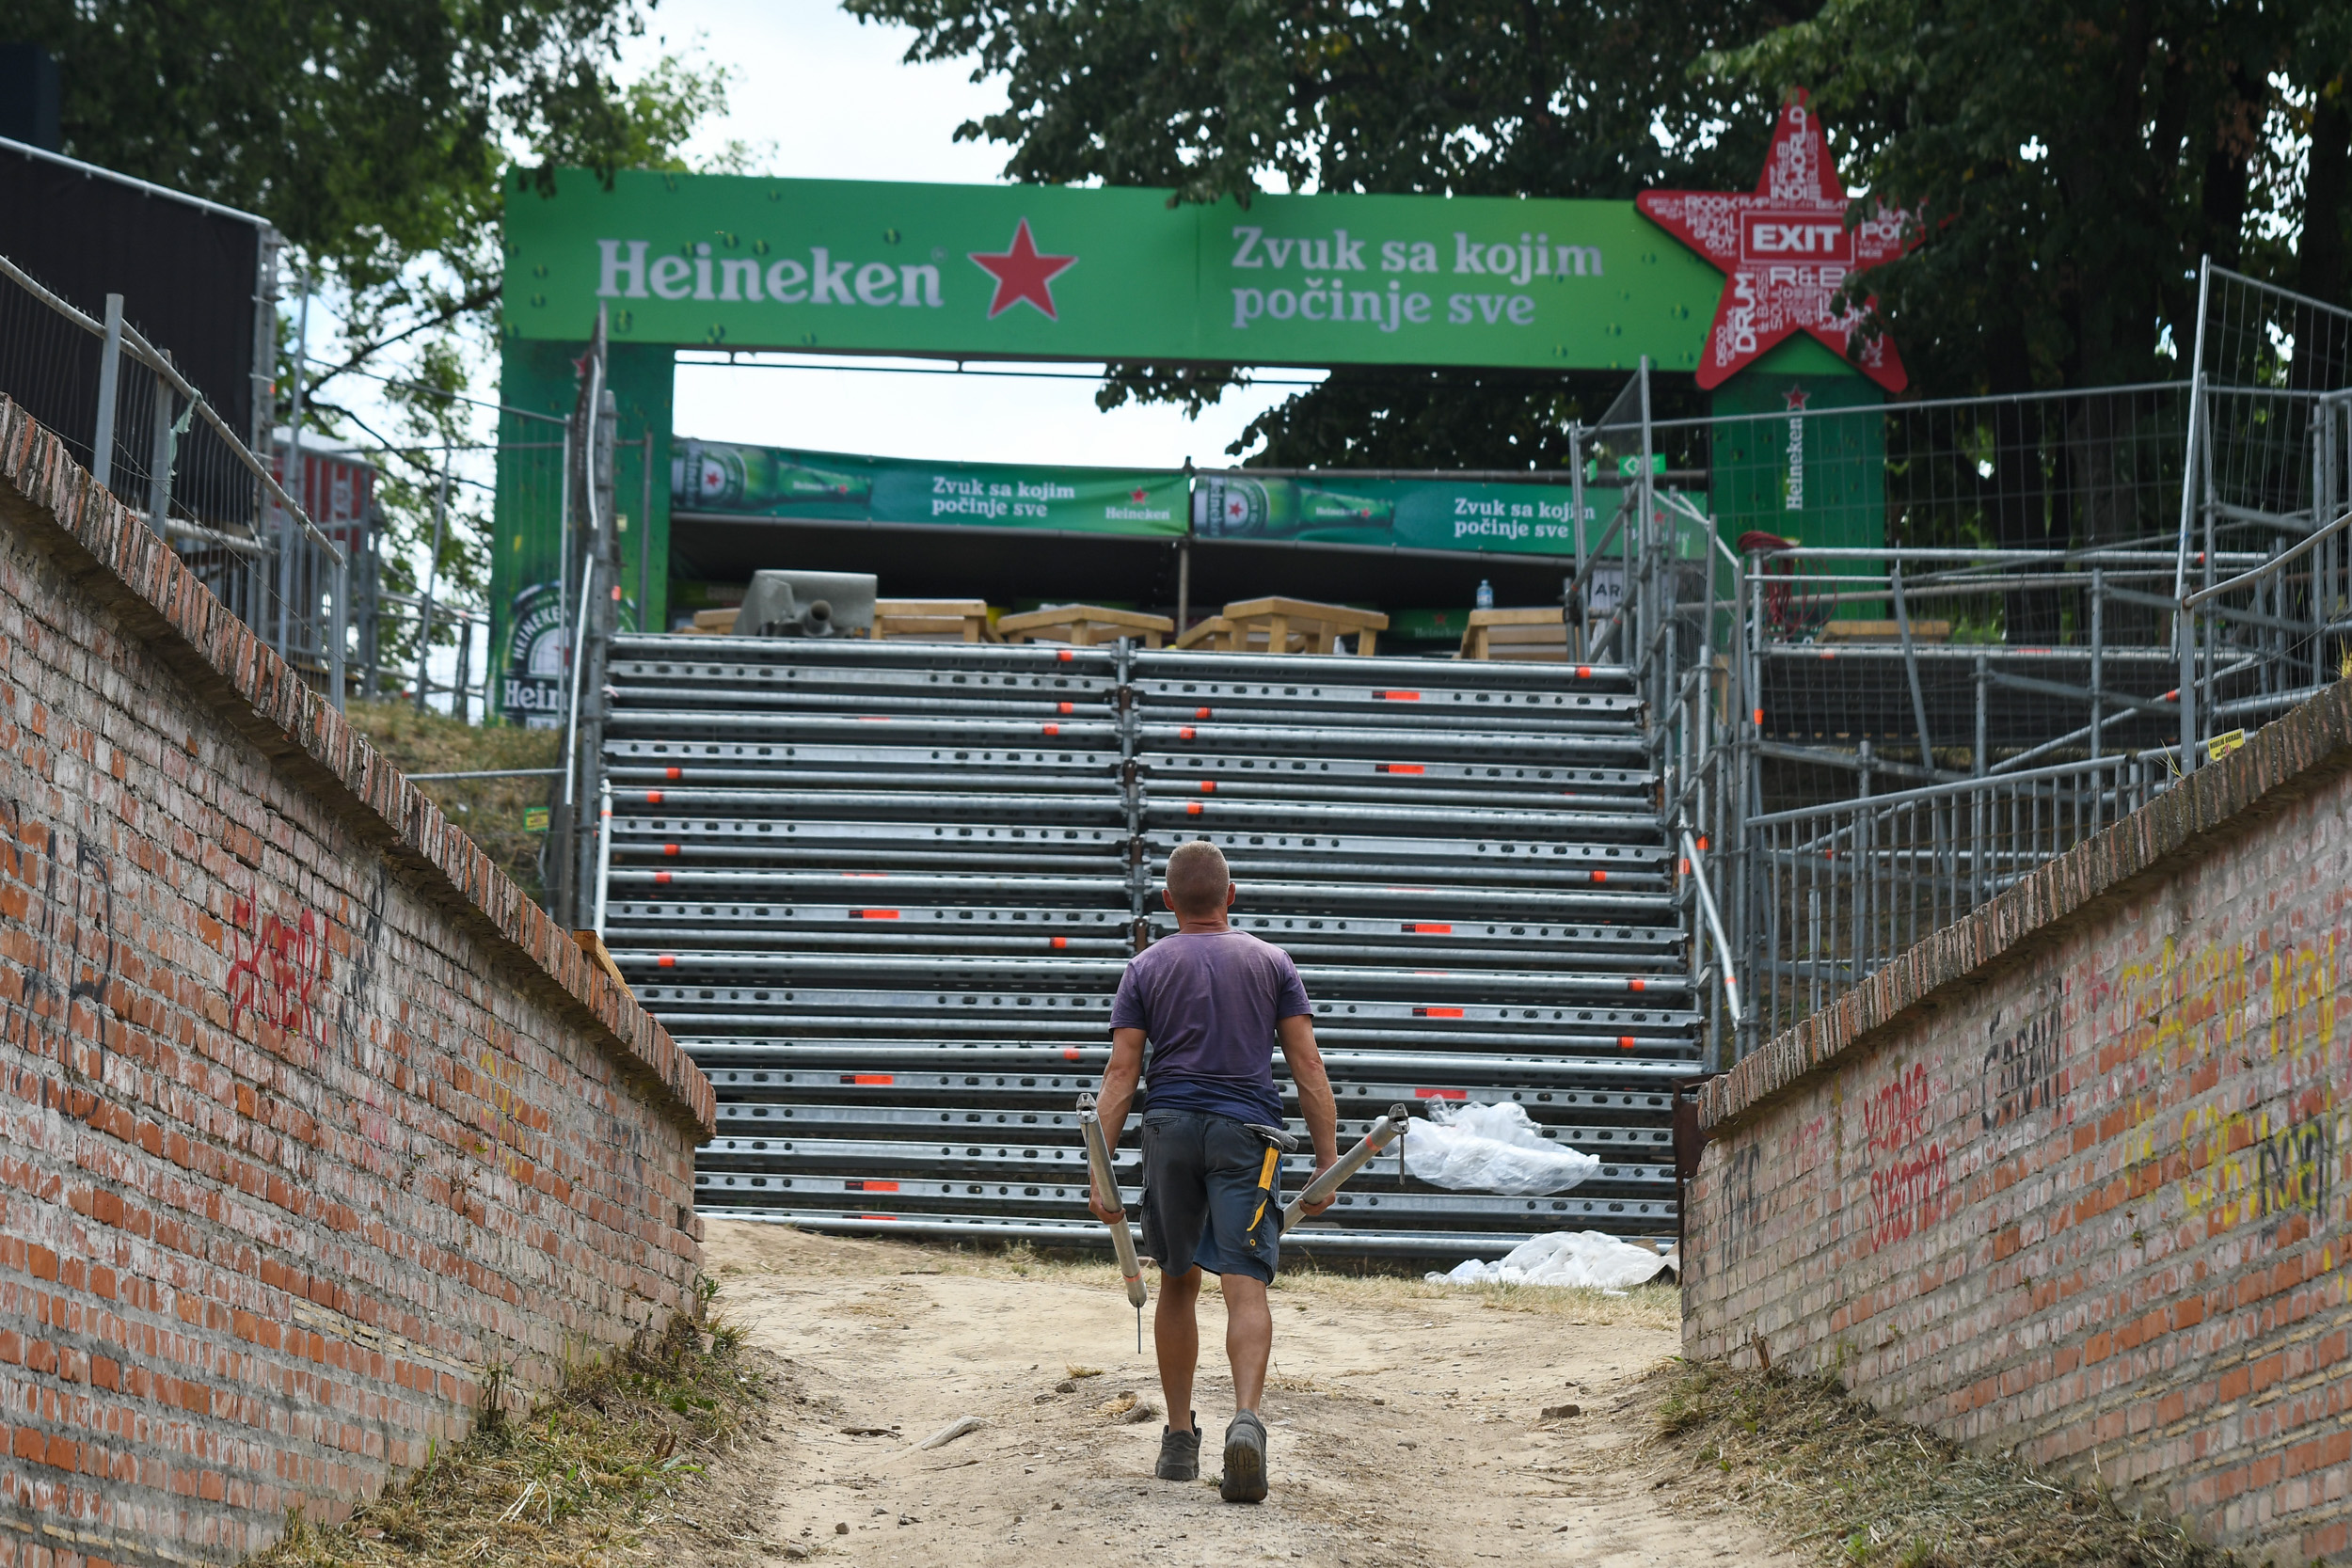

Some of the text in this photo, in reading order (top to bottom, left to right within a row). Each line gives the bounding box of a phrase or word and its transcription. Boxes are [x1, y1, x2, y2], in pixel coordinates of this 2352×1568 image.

[1789, 105, 1806, 184] WORLD
[1771, 184, 1821, 200] INDIE
[1753, 224, 1842, 252] EXIT
[1232, 226, 1603, 286] Zvuk sa kojim
[596, 239, 944, 308] Heineken
[1770, 266, 1846, 287] R&B
[1232, 277, 1535, 332] počinje sve
[1734, 273, 1756, 353] DRUM
[1786, 417, 1803, 511] Heineken
[932, 476, 1075, 501] Zvuk sa kojim
[931, 496, 1048, 520] počinje sve
[1105, 506, 1171, 521] Heineken
[1454, 498, 1505, 517] Zvuk
[1510, 504, 1534, 518] sa
[1454, 518, 1568, 540] počinje sve
[514, 604, 570, 660] HEINEKE
